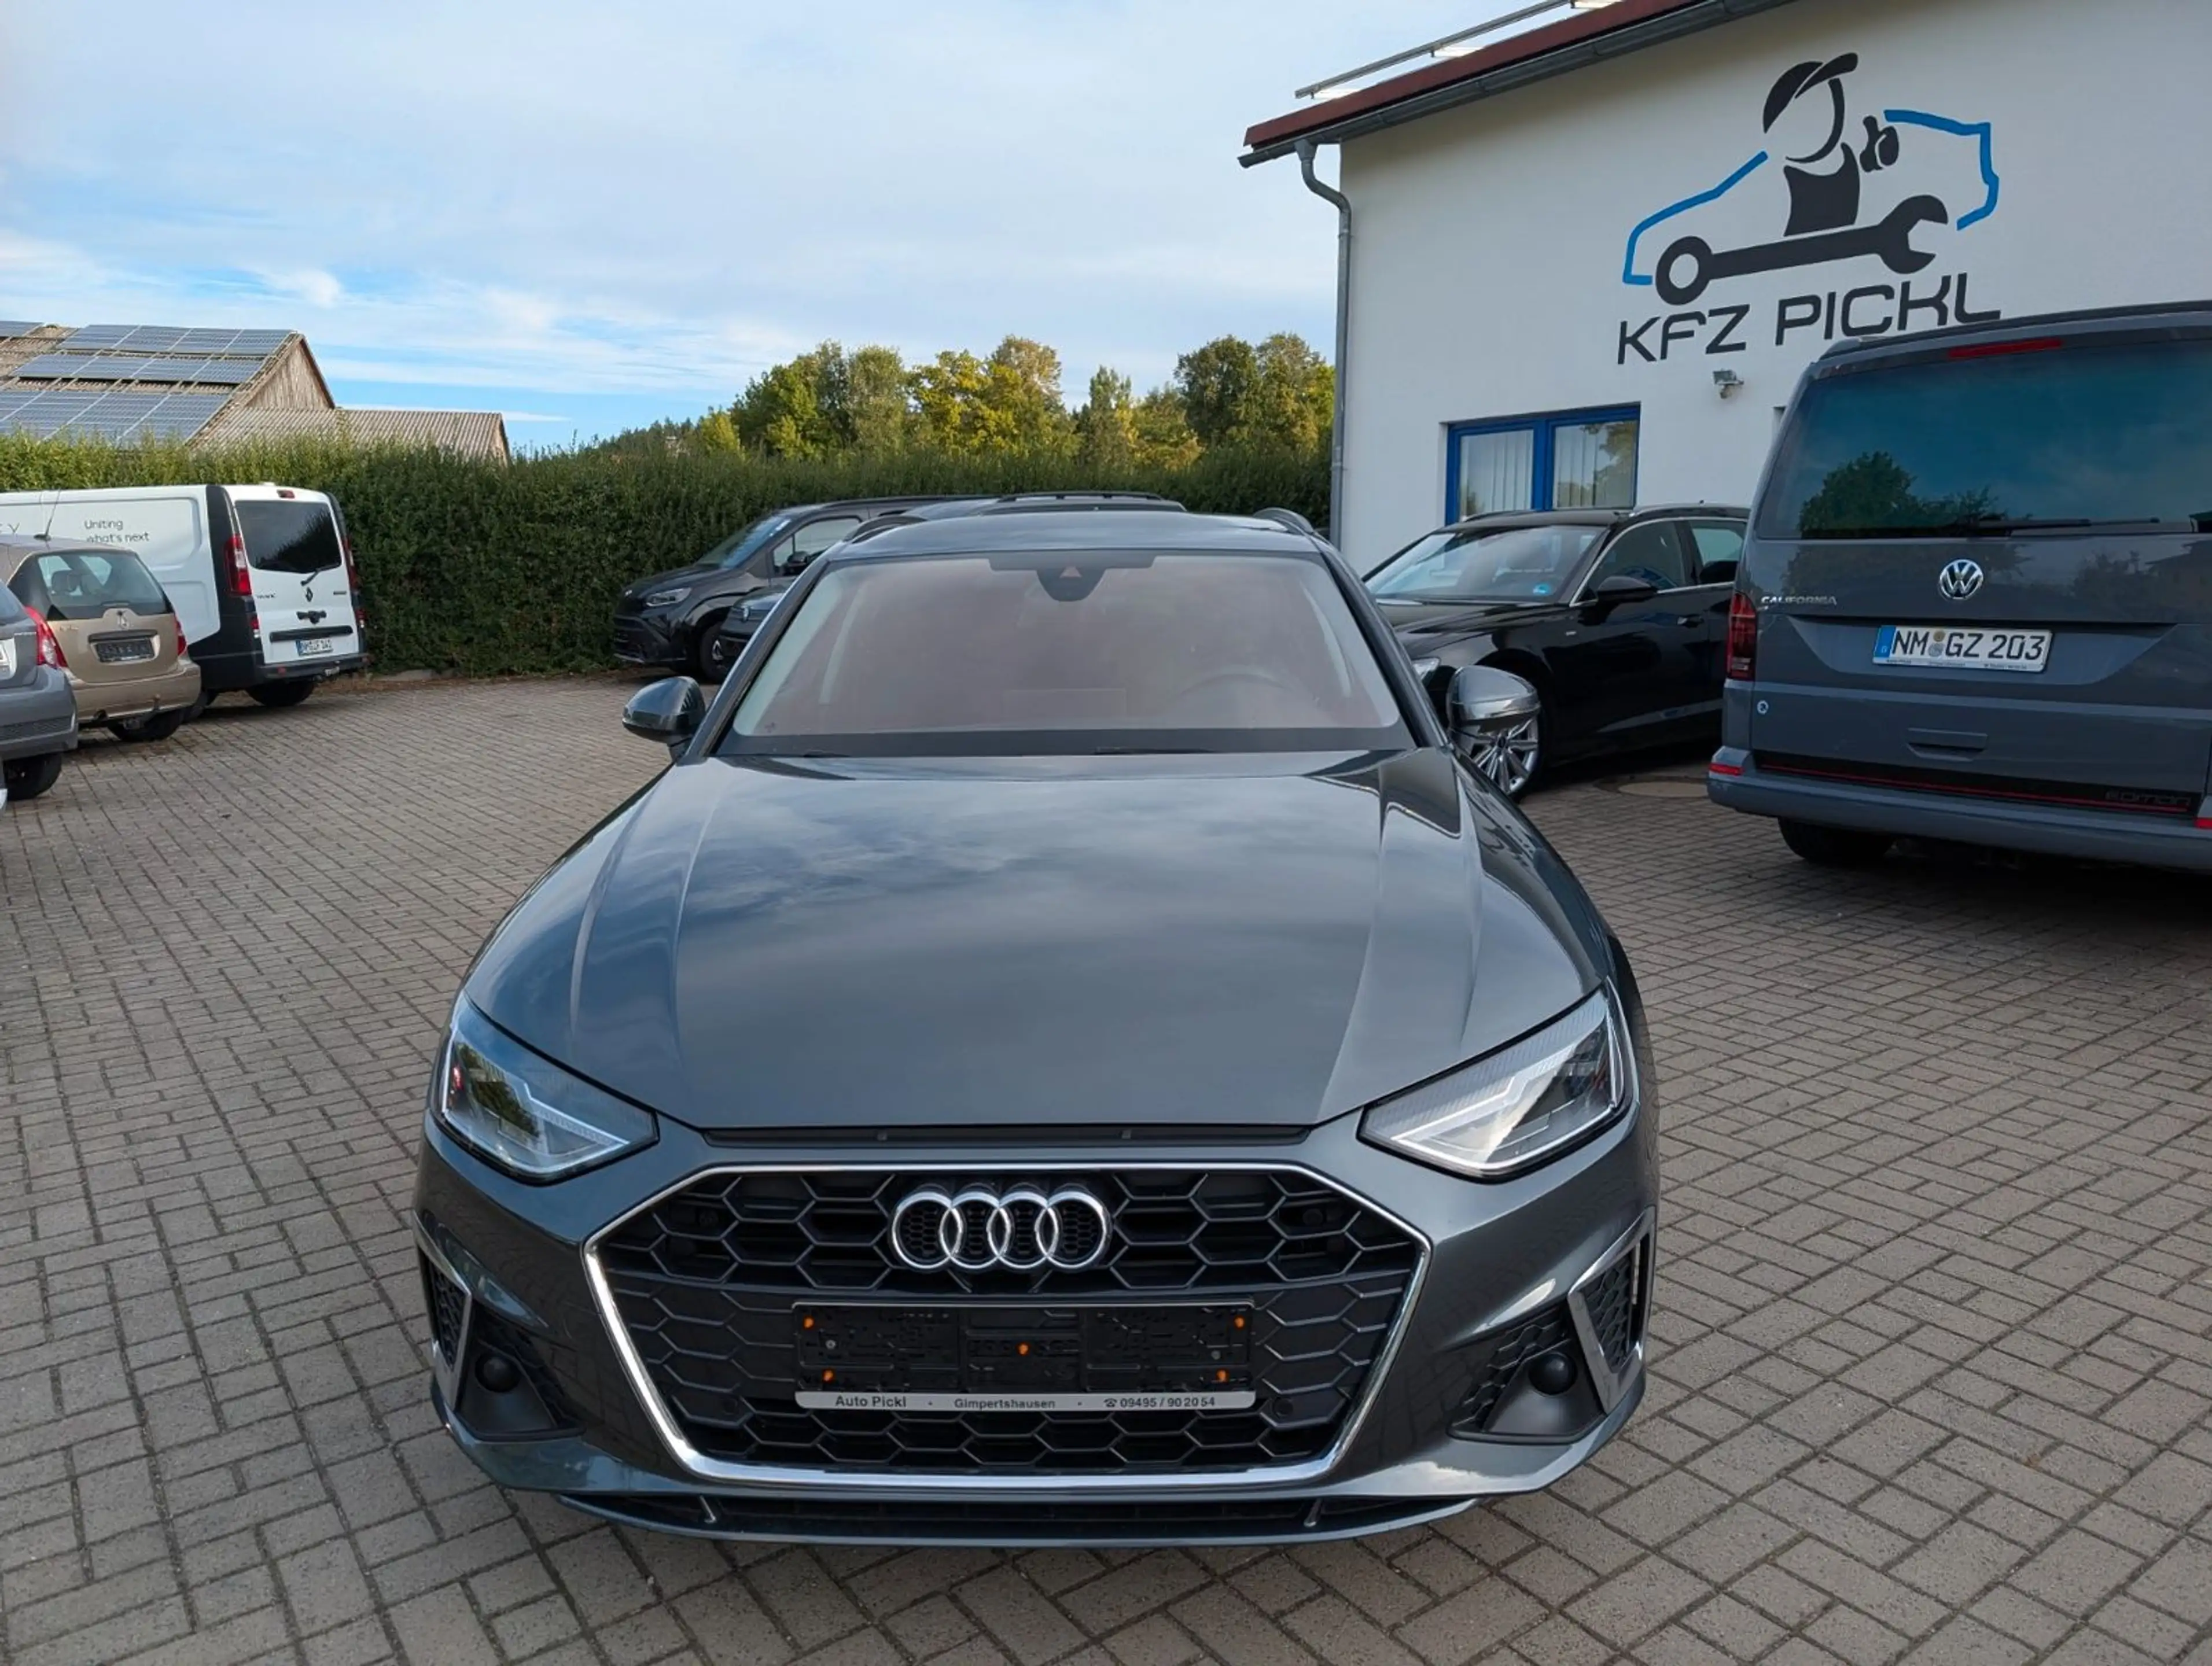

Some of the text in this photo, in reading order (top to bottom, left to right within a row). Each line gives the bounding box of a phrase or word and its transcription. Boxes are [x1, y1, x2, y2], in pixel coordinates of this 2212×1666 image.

[1775, 272, 2001, 346] PICKL
[84, 520, 123, 531] Uniting
[125, 532, 150, 542] next
[1761, 595, 1838, 606] CALIFORNIA
[1892, 629, 1930, 655] NM
[1945, 632, 1984, 658] GZ
[1988, 634, 2045, 661] 203
[835, 1395, 868, 1407] Auto
[872, 1395, 907, 1407] Pickl
[954, 1397, 1055, 1410] Gimpertshausen
[1120, 1396, 1157, 1408] 09495
